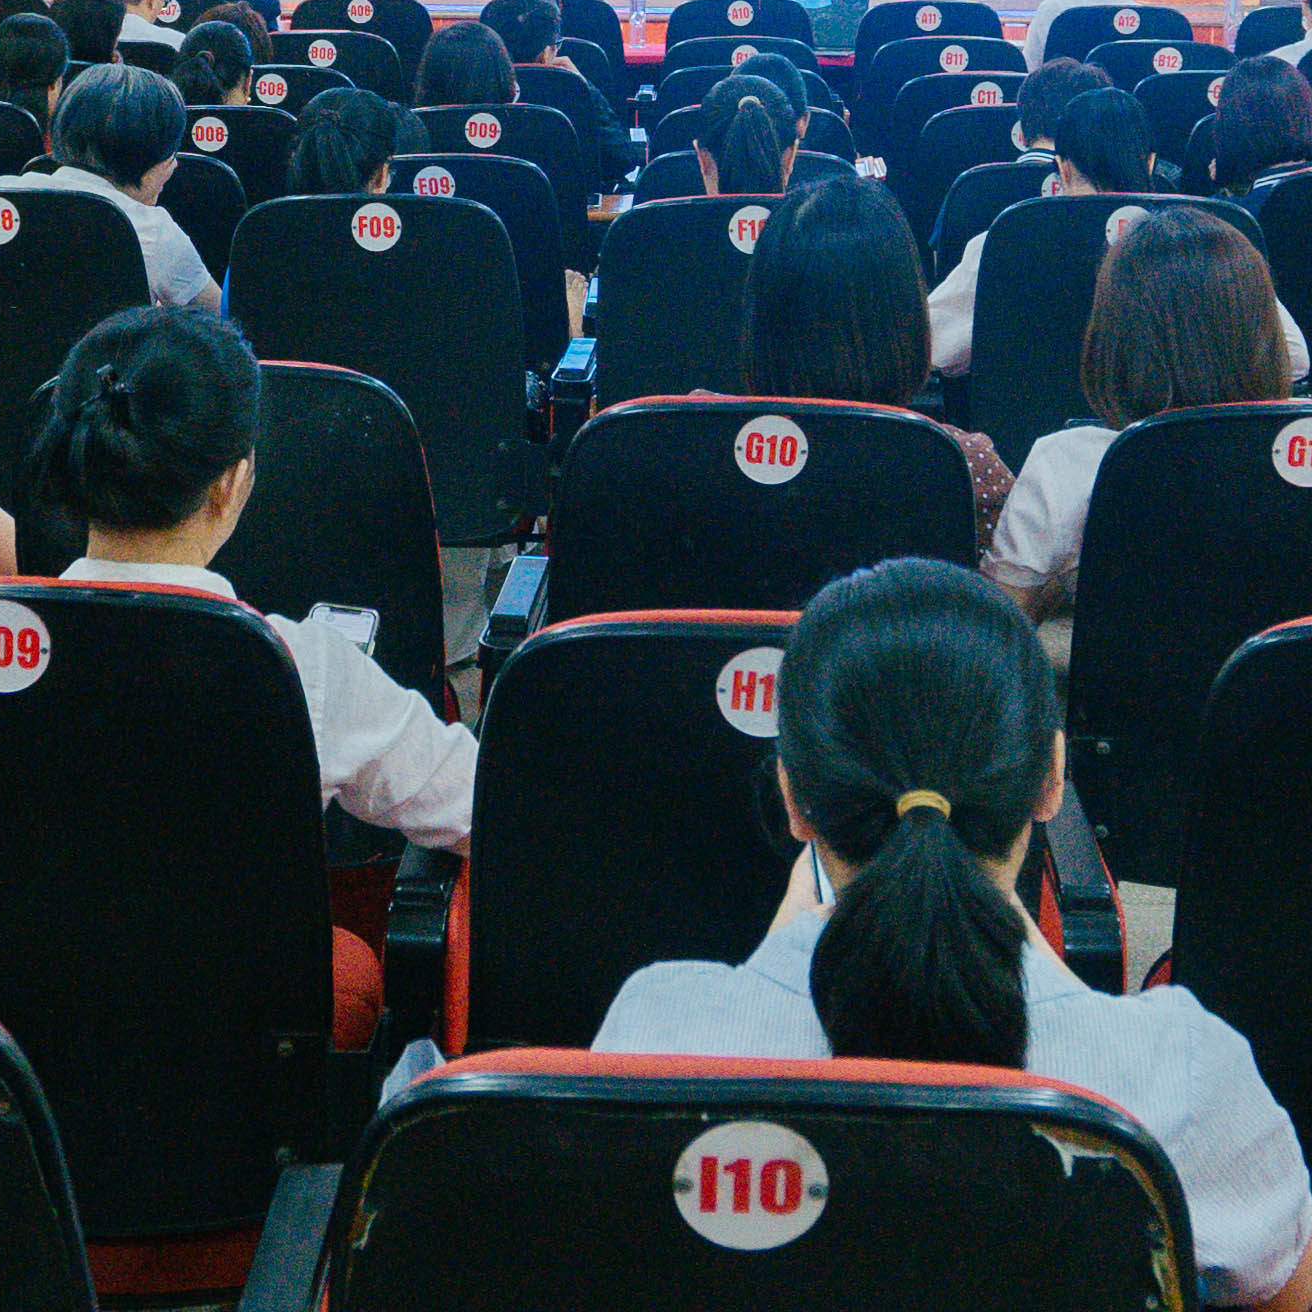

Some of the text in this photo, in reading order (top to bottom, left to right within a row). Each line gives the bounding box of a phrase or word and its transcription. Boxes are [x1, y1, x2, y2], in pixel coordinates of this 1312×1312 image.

[735, 52, 748, 64] B1
[1158, 54, 1178, 69] B12
[258, 80, 285, 97] C08
[977, 90, 997, 105] C11
[195, 126, 224, 142] D08
[469, 122, 498, 138] D09
[419, 176, 450, 195] E09
[358, 216, 395, 238] F09
[738, 219, 764, 241] F1
[745, 432, 798, 467] G10
[731, 669, 774, 712] H1
[698, 1155, 803, 1215] I10
